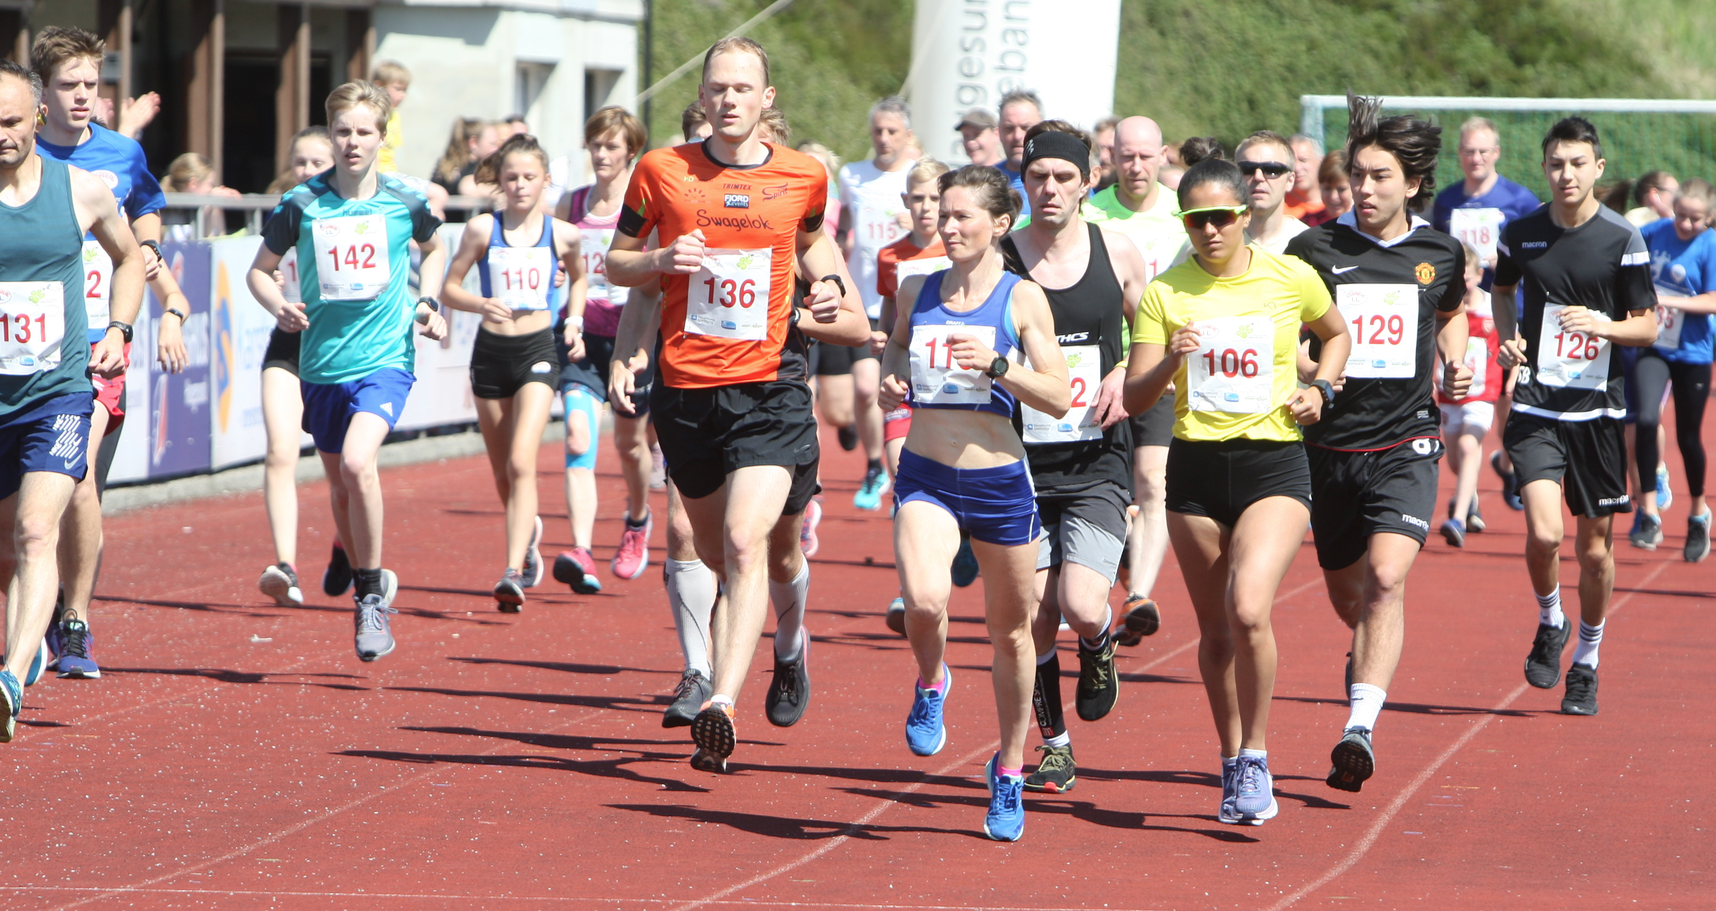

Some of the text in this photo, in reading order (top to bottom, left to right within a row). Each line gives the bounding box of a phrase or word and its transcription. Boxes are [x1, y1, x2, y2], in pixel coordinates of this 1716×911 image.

[722, 183, 752, 191] TRIMTEX
[724, 194, 749, 203] FJORD
[761, 181, 788, 202] Spirit
[696, 209, 774, 232] Swagelok
[867, 221, 898, 240] 115
[1461, 226, 1490, 244] 118
[1521, 241, 1548, 249] macron
[327, 242, 376, 272] 142
[501, 267, 540, 291] 110
[703, 276, 756, 309] 136
[0, 312, 47, 344] 131
[1351, 314, 1404, 346] 129
[1553, 331, 1600, 361] 126
[1202, 347, 1259, 379] 106
